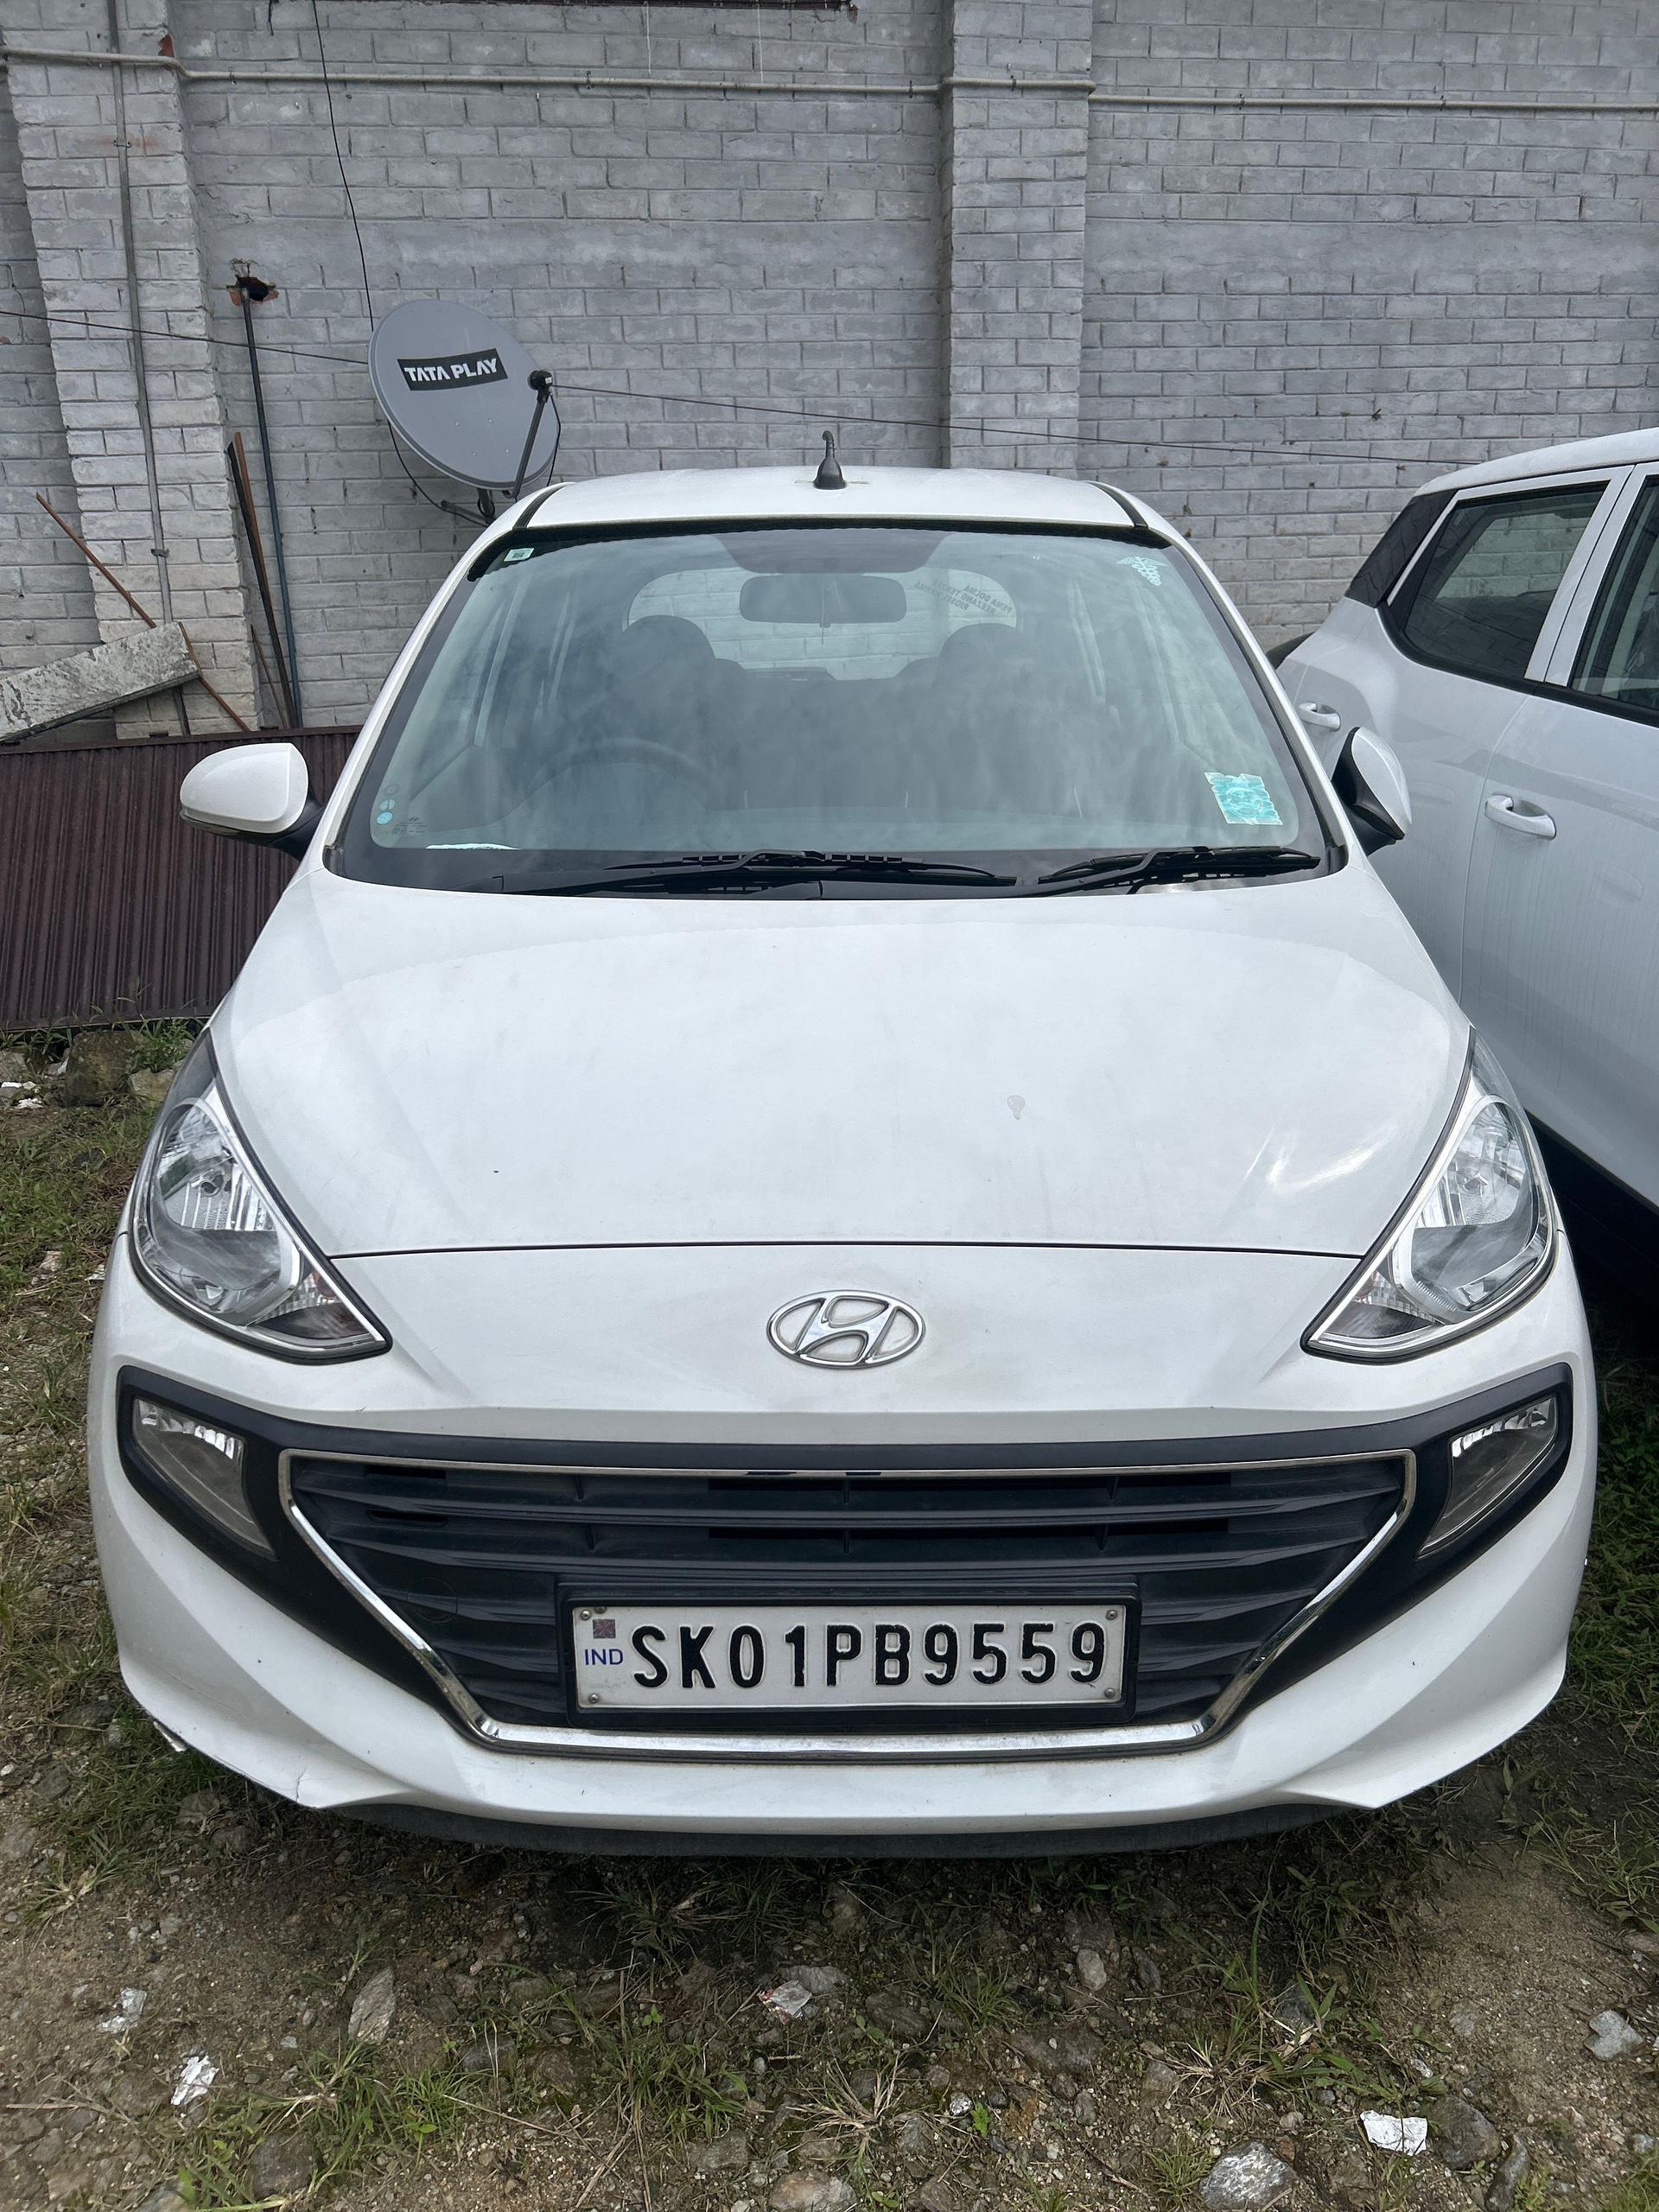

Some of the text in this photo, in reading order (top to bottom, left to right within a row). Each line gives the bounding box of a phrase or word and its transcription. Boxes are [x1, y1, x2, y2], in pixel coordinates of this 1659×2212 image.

[404, 358, 497, 382] TATA PLAY
[584, 1649, 623, 1666] IND
[632, 1624, 1105, 1688] SK01PB9559
